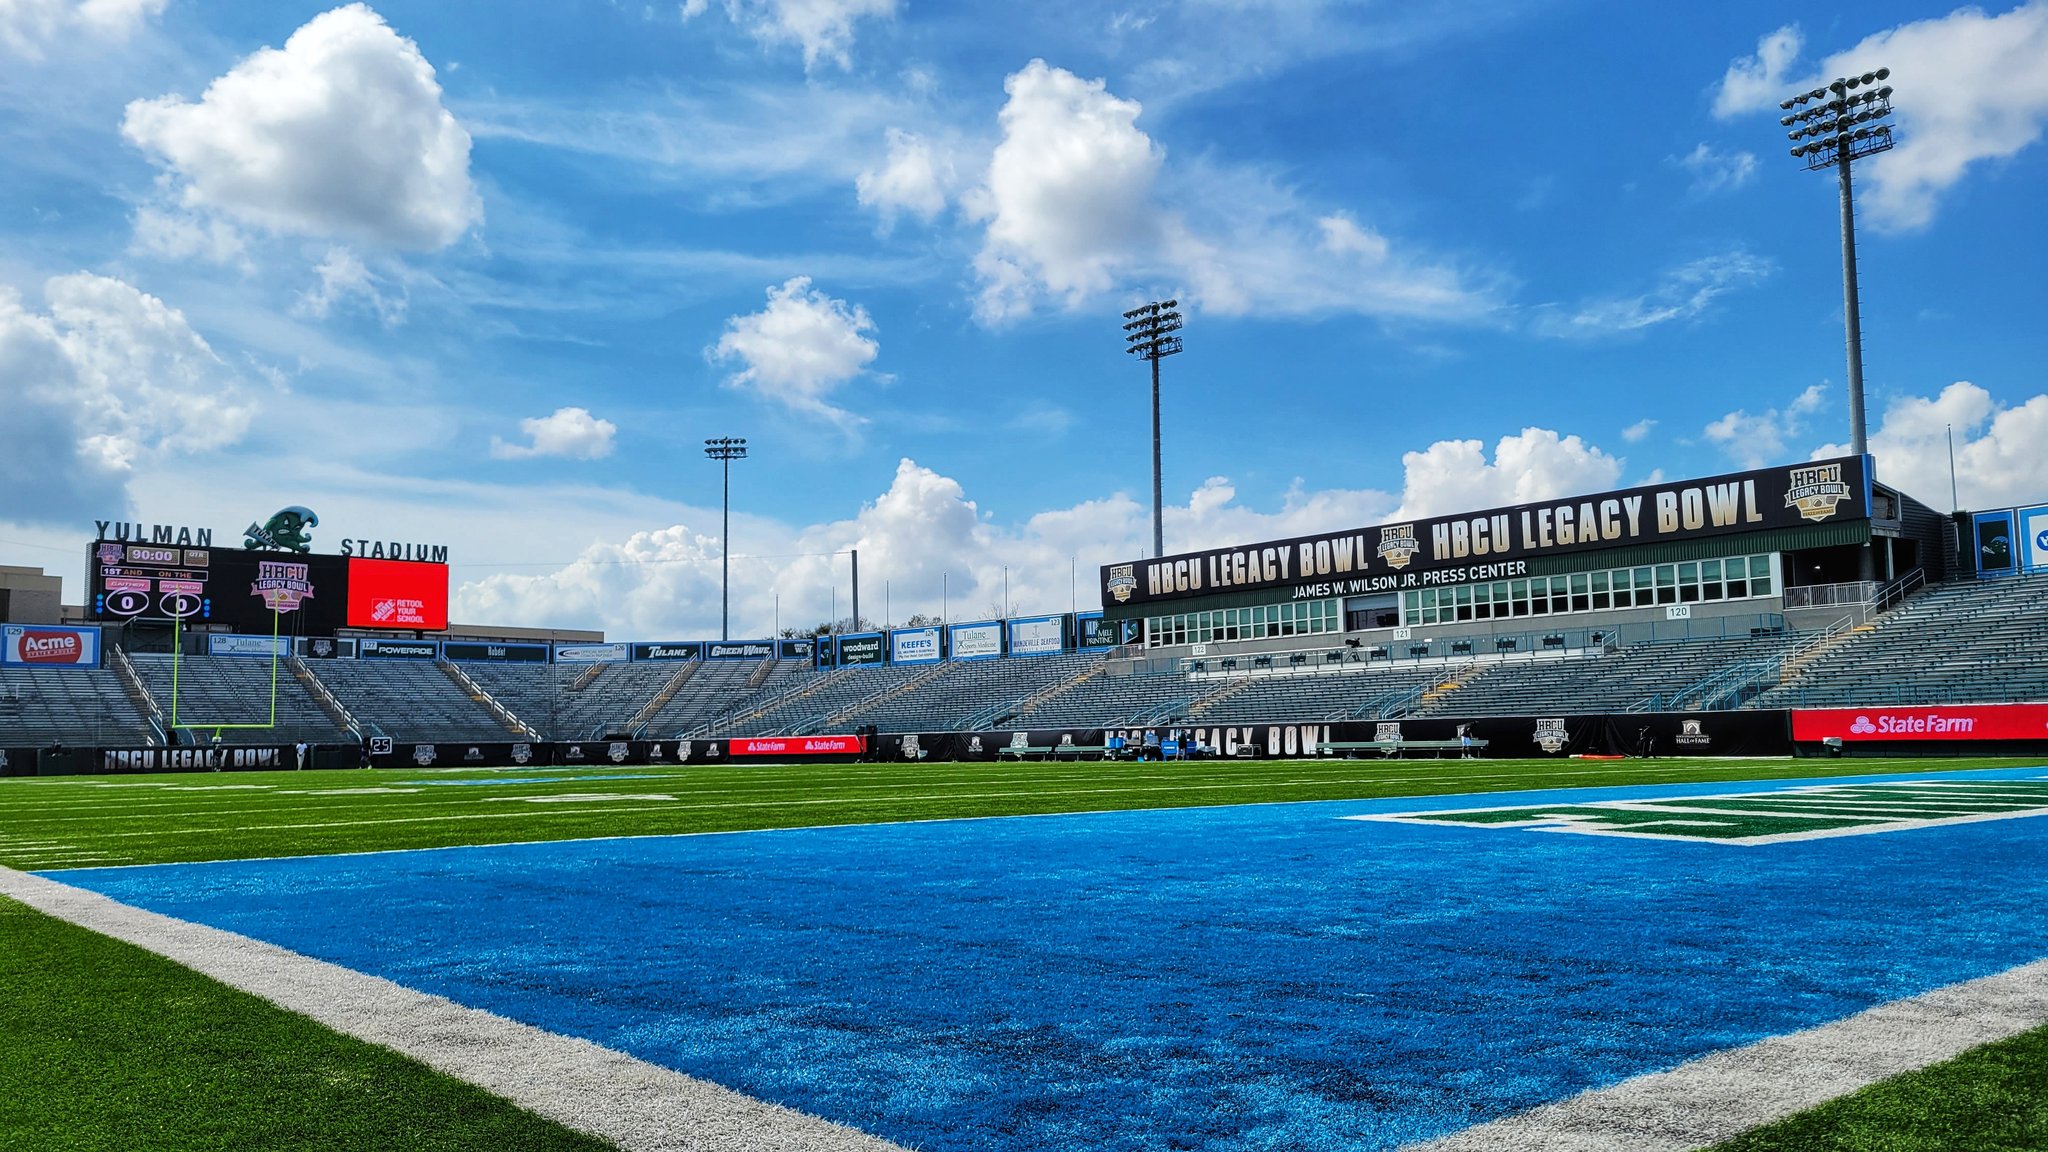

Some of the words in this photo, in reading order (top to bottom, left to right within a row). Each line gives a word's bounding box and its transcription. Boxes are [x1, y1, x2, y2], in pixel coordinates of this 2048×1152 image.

[1794, 467, 1837, 487] HBCU
[1792, 486, 1818, 500] LEGACY
[1820, 484, 1842, 494] BOWL
[1432, 514, 1510, 561] HBCU
[1521, 496, 1642, 550] LEGACY
[1656, 480, 1763, 533] BOWL
[95, 520, 212, 546] YULMAN
[1382, 526, 1411, 541] HBCU
[132, 549, 173, 561] 90:00
[341, 538, 448, 562] STADIUM
[1148, 557, 1202, 595] HBCU
[1209, 546, 1291, 588] LEGACY
[1300, 535, 1368, 577] BOWL
[123, 569, 143, 577] AND
[175, 571, 192, 579] THE
[261, 564, 306, 581] HBCU
[1111, 565, 1131, 579] HBCU
[259, 580, 286, 590] LEGACY
[287, 581, 308, 592] BOWL
[1292, 583, 1330, 600] JAMES
[1333, 581, 1347, 595] W.
[1350, 575, 1397, 592] WILSON
[1401, 573, 1420, 588] JR.
[1423, 568, 1466, 585] PRESS
[1469, 561, 1527, 580] CENTER
[121, 596, 134, 610] 0
[397, 607, 416, 615] YOUR
[1671, 607, 1687, 617] 120
[396, 615, 424, 623] SCHOOL
[7, 627, 22, 635] 129
[962, 630, 986, 641] Tulane
[1395, 630, 1408, 639] 121
[25, 636, 75, 652] Acme
[843, 641, 879, 652] woodward
[901, 639, 932, 649] KEEFE'S
[1086, 636, 1113, 647] PRINTING
[379, 646, 434, 655] POWERADE
[648, 646, 687, 658] TULANE
[1194, 646, 1205, 654] 122
[1538, 720, 1563, 731] HBCU
[373, 740, 389, 751] 25
[104, 750, 154, 769] HBCU
[234, 748, 282, 767] BOWL
